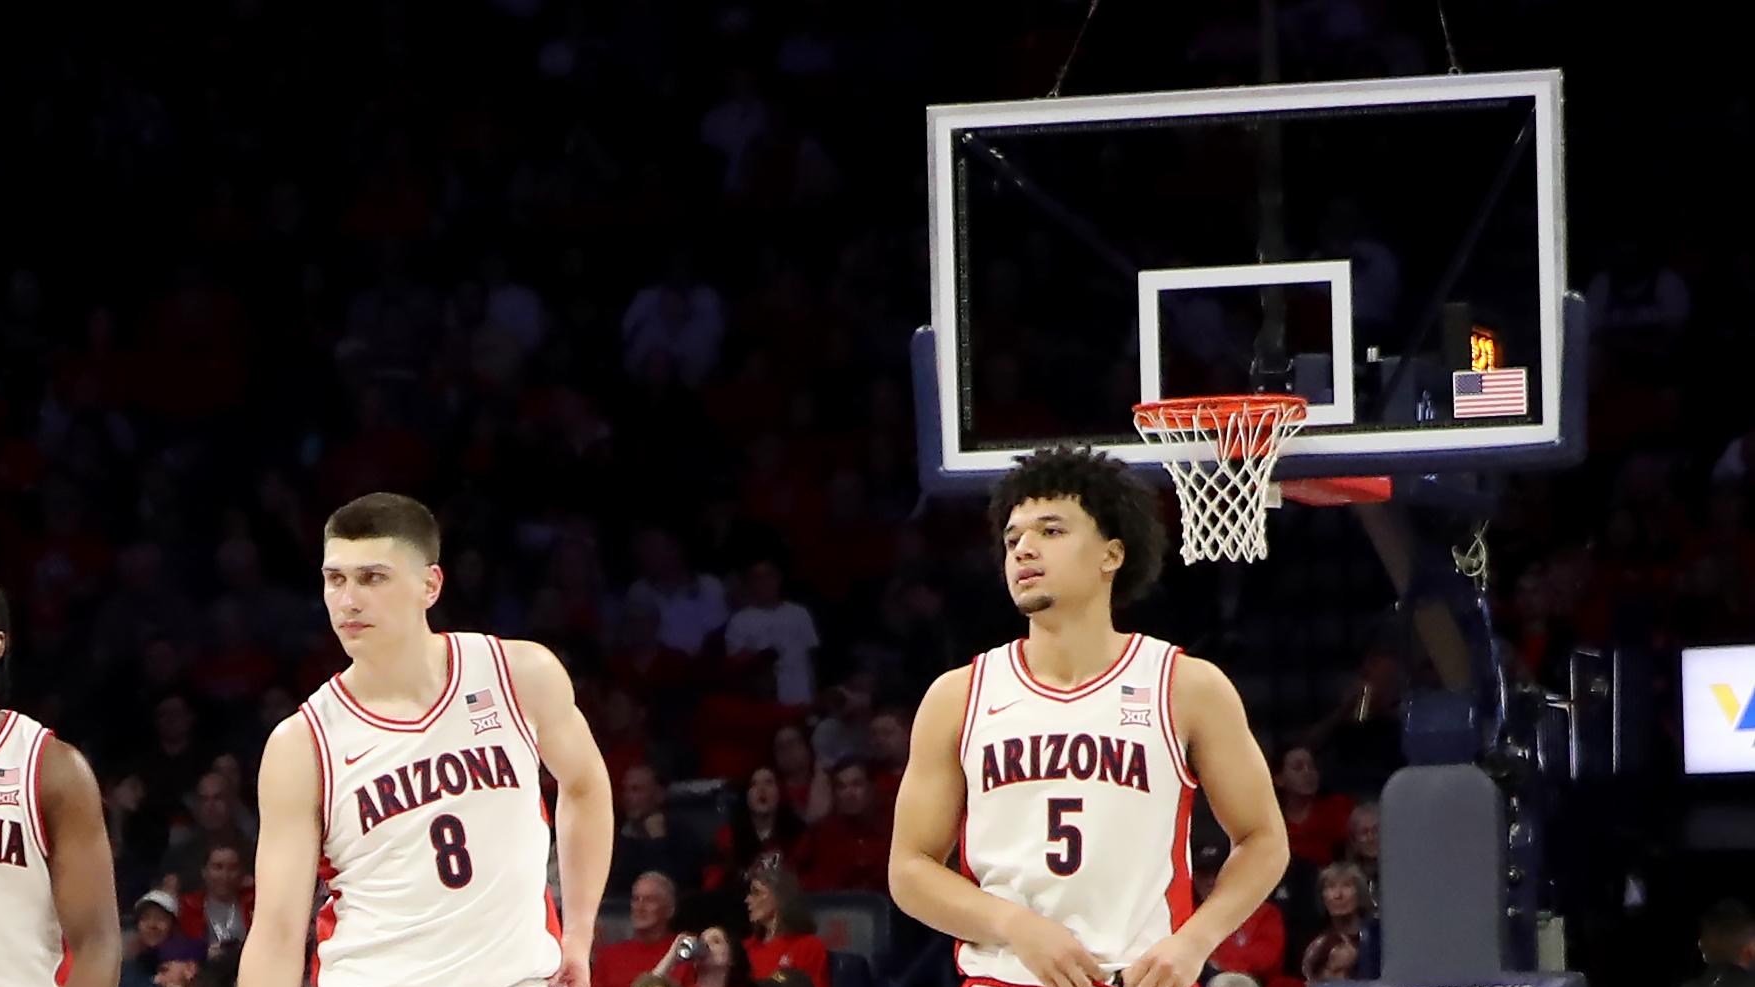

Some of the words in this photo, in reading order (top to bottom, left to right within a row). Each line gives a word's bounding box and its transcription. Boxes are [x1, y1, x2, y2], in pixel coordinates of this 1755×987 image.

[354, 745, 520, 837] ARIZONA
[981, 732, 1151, 794] ARIZONA
[429, 813, 473, 889] 8
[1045, 797, 1084, 877] 5
